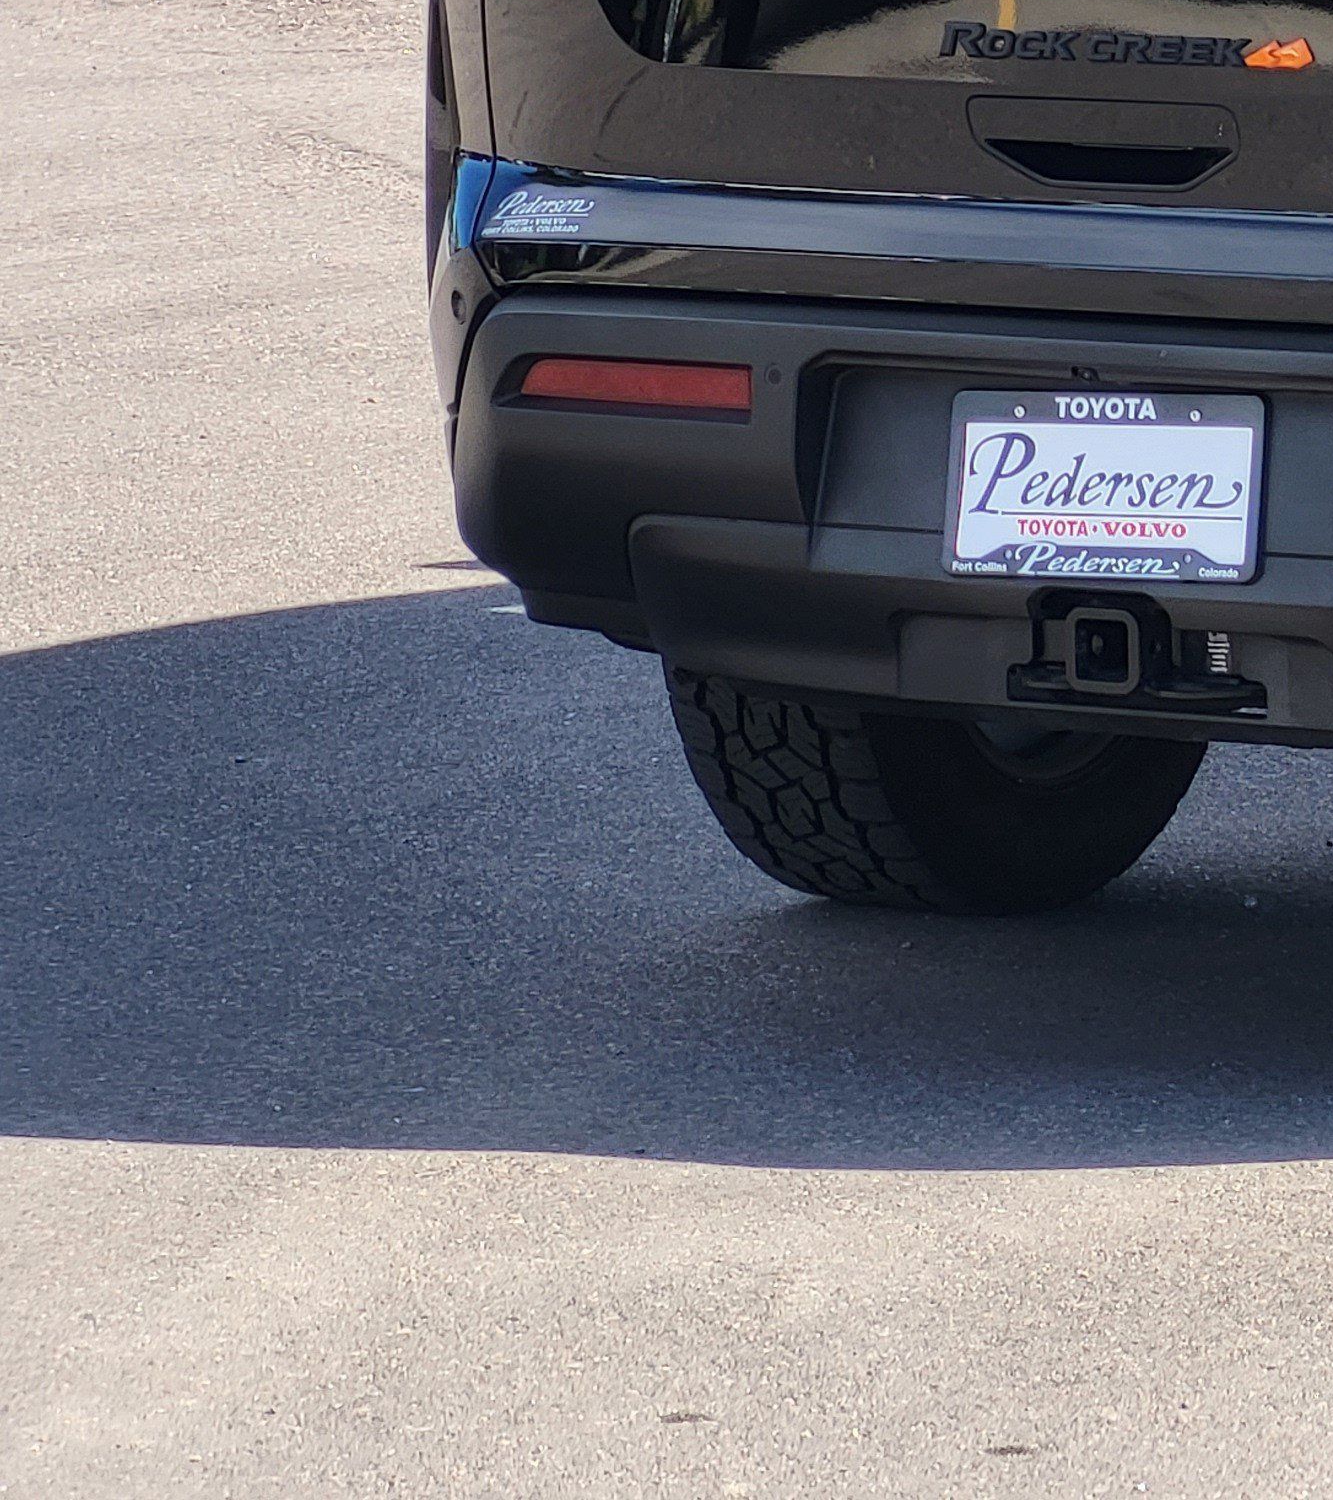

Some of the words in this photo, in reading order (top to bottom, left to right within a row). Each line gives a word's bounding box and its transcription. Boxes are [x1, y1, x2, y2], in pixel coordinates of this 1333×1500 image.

[939, 20, 1078, 61] ROCK
[1086, 32, 1251, 67] CREEK
[493, 191, 594, 219] Pedersen
[1055, 396, 1157, 420] TOYOTA
[968, 432, 1243, 514] Pedersen
[1018, 519, 1088, 537] TOYOTA
[1101, 521, 1187, 538] VOLVO
[952, 561, 973, 572] Fort
[974, 561, 1008, 572] Collins
[1015, 541, 1180, 575] Pedersen
[1198, 567, 1240, 579] Colorado
